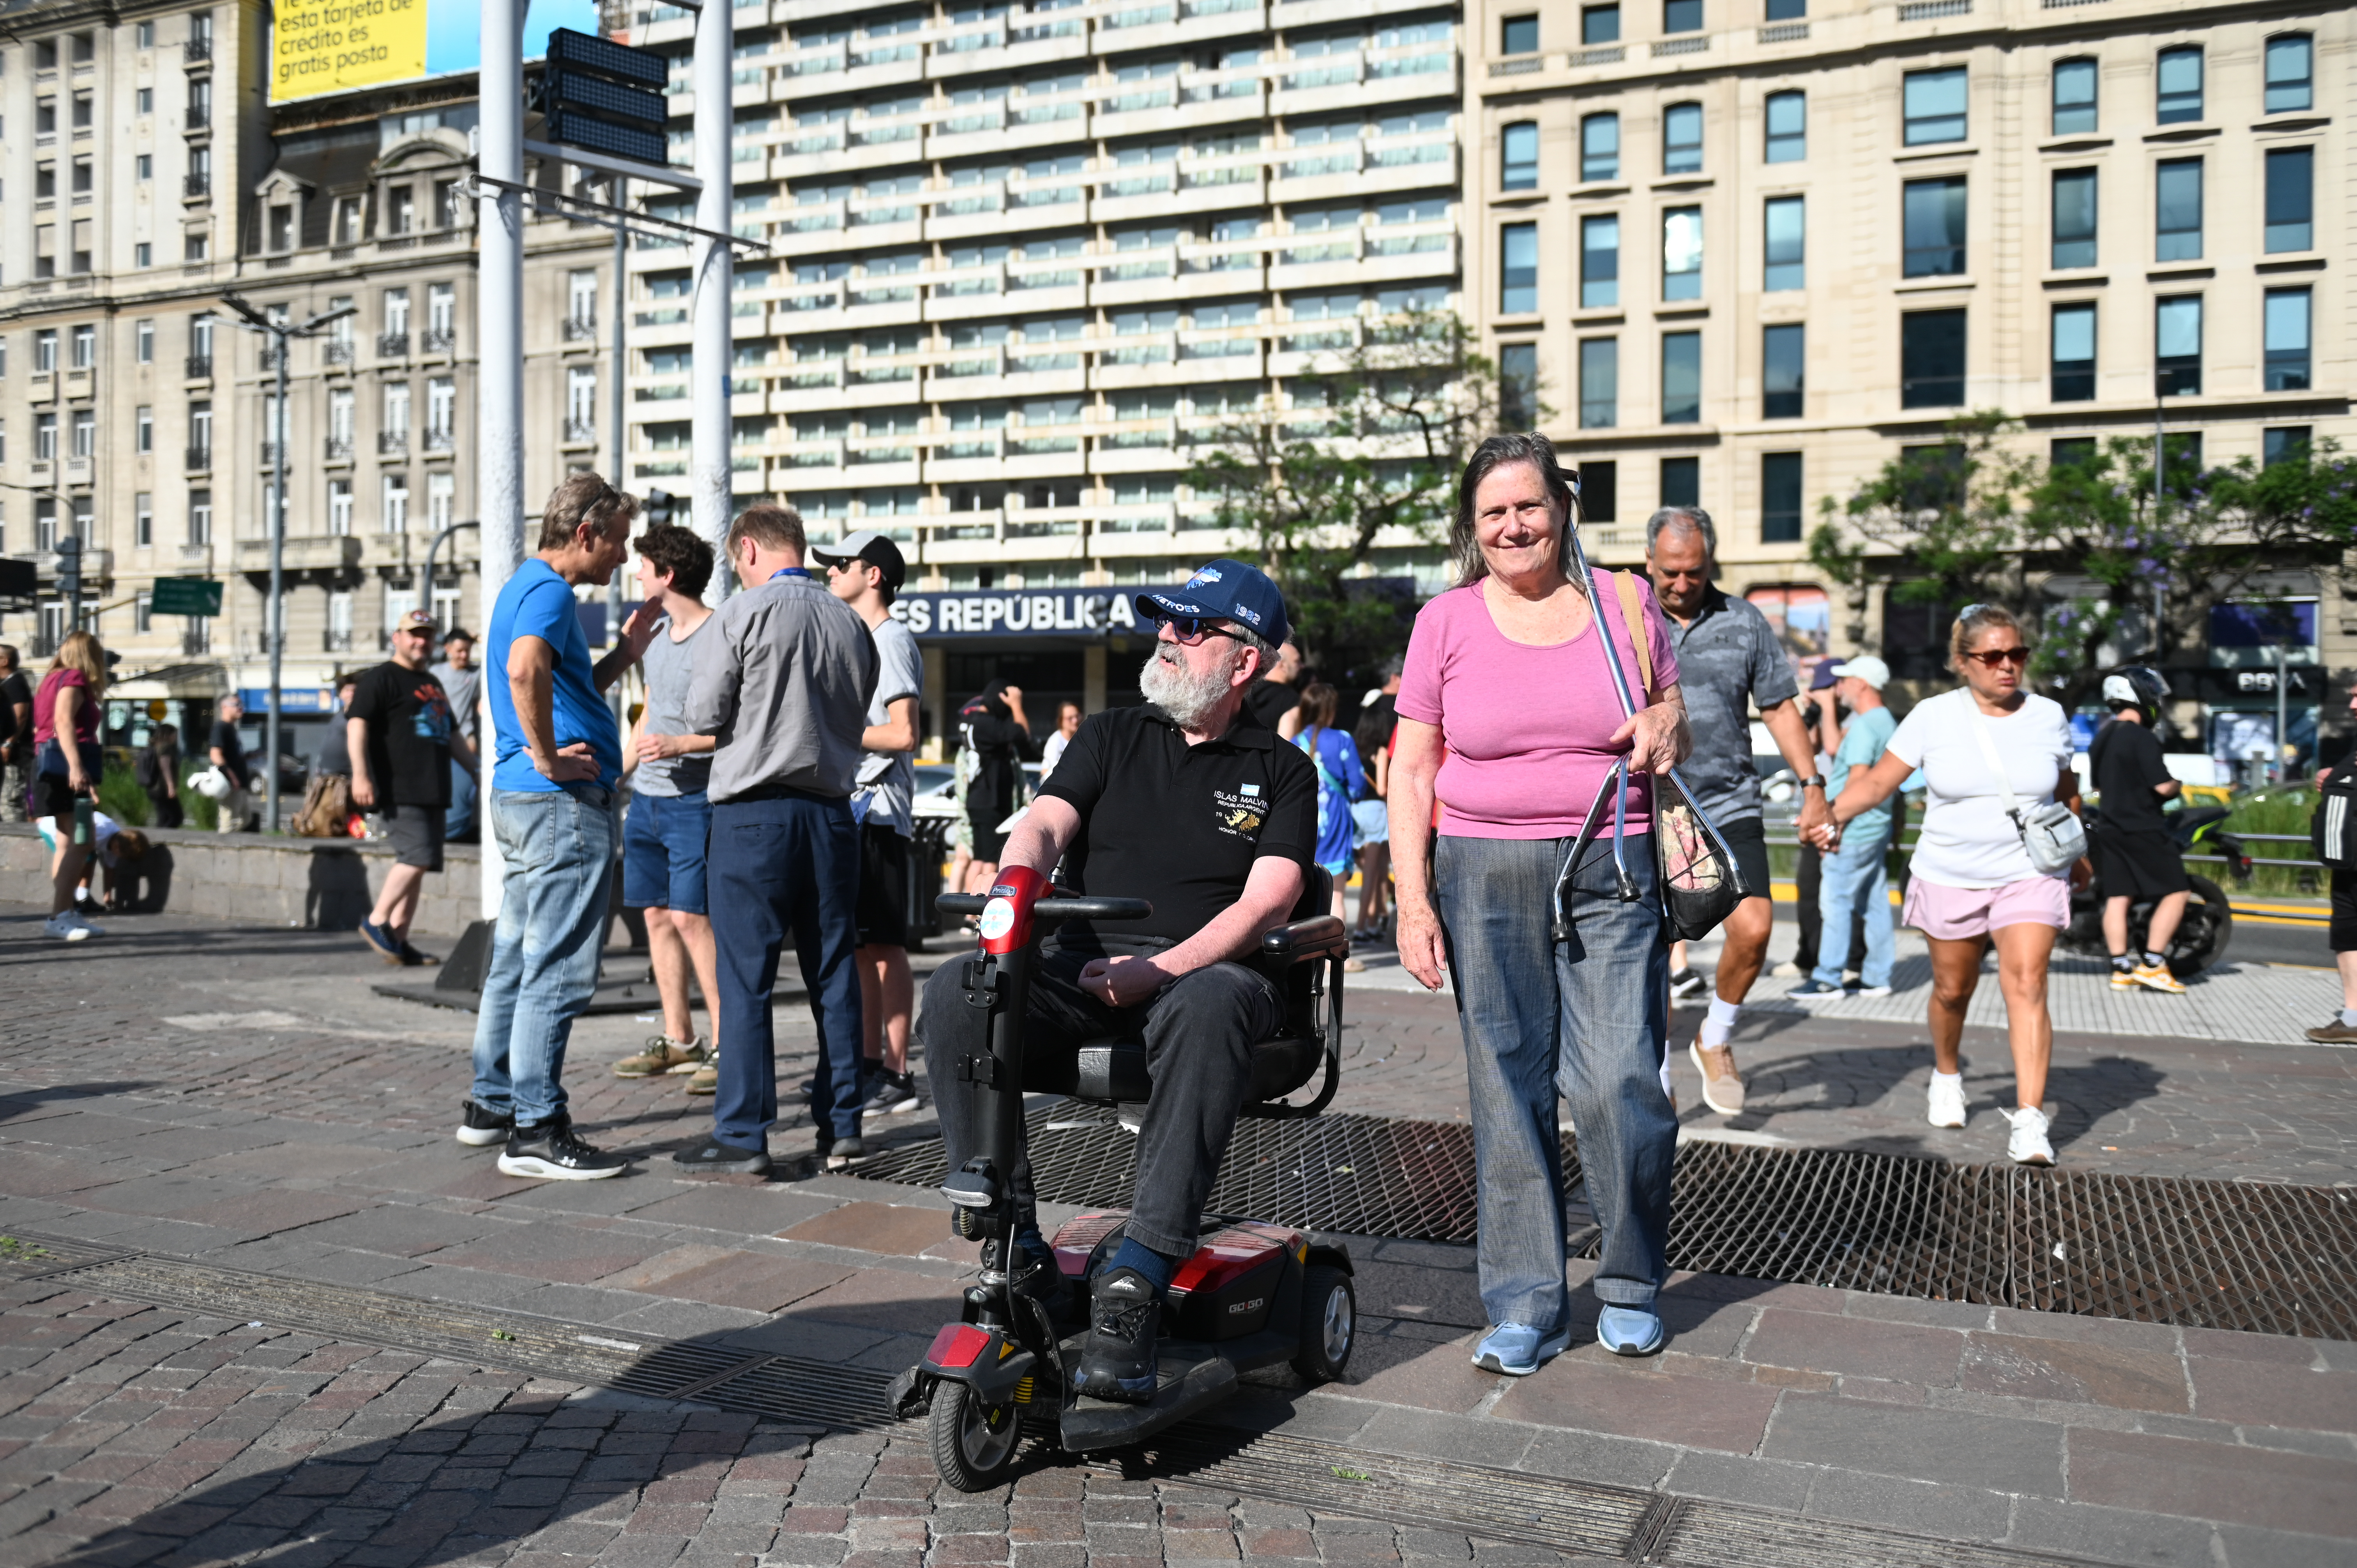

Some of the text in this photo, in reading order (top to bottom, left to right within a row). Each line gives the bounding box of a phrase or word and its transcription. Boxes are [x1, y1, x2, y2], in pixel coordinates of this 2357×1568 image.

[281, 12, 318, 32] esta
[324, 0, 383, 25] tarjeta
[390, 0, 412, 11] de
[281, 25, 368, 55] crédito es
[280, 44, 387, 83] gratis posta
[1152, 594, 1200, 613] HEROES
[1235, 603, 1261, 625] 1982
[1214, 790, 1269, 810] ISLAS MALVIN
[1217, 800, 1266, 816] REPUBLICA ARGENT
[1218, 826, 1237, 835] HONOR
